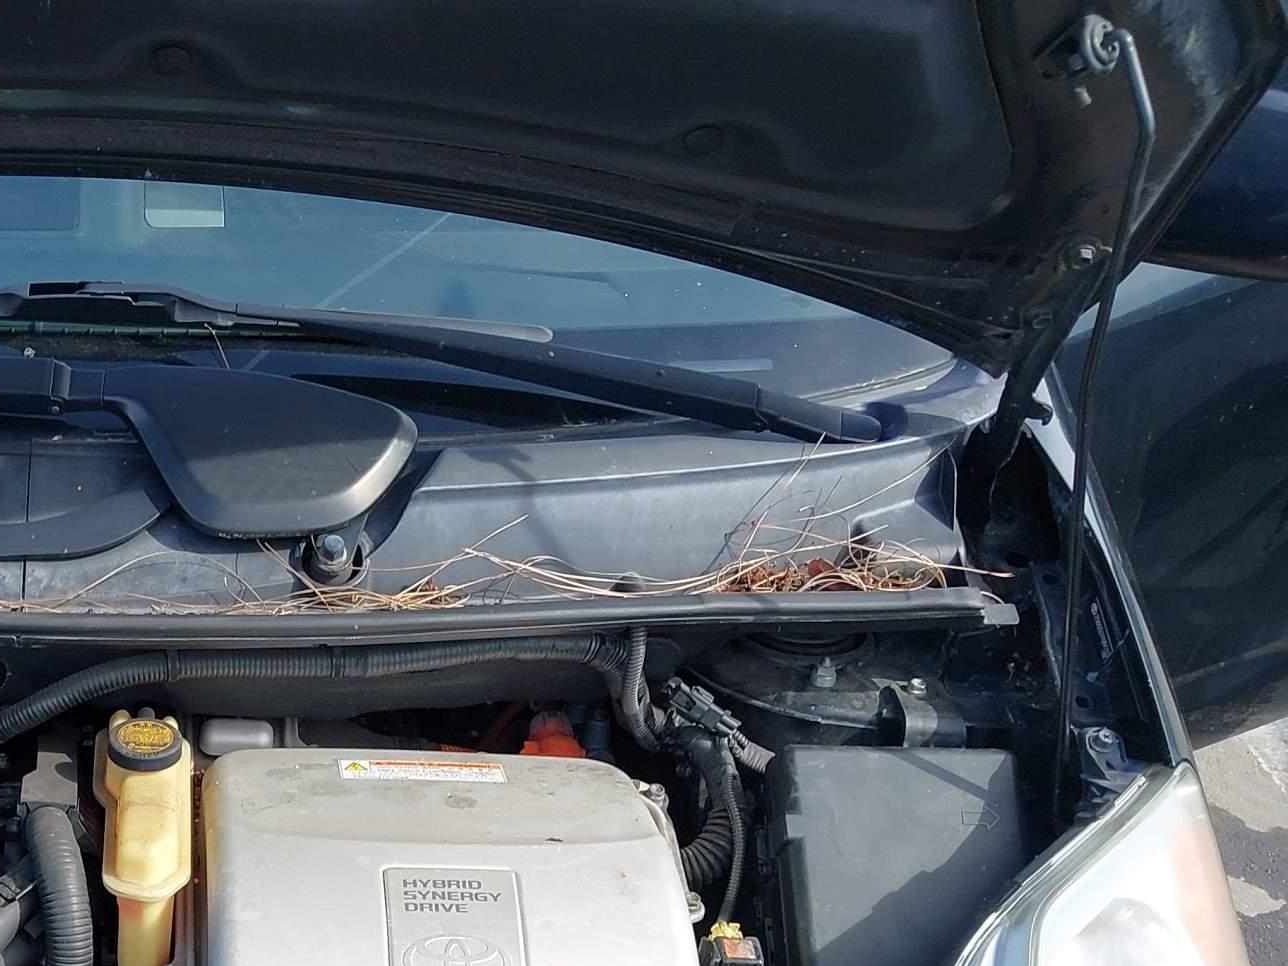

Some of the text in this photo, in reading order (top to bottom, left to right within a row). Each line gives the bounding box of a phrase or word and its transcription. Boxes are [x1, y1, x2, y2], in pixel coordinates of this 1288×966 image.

[402, 878, 482, 890] HYBRID
[403, 890, 502, 902] SYNERGY
[404, 902, 469, 913] DRIVE
